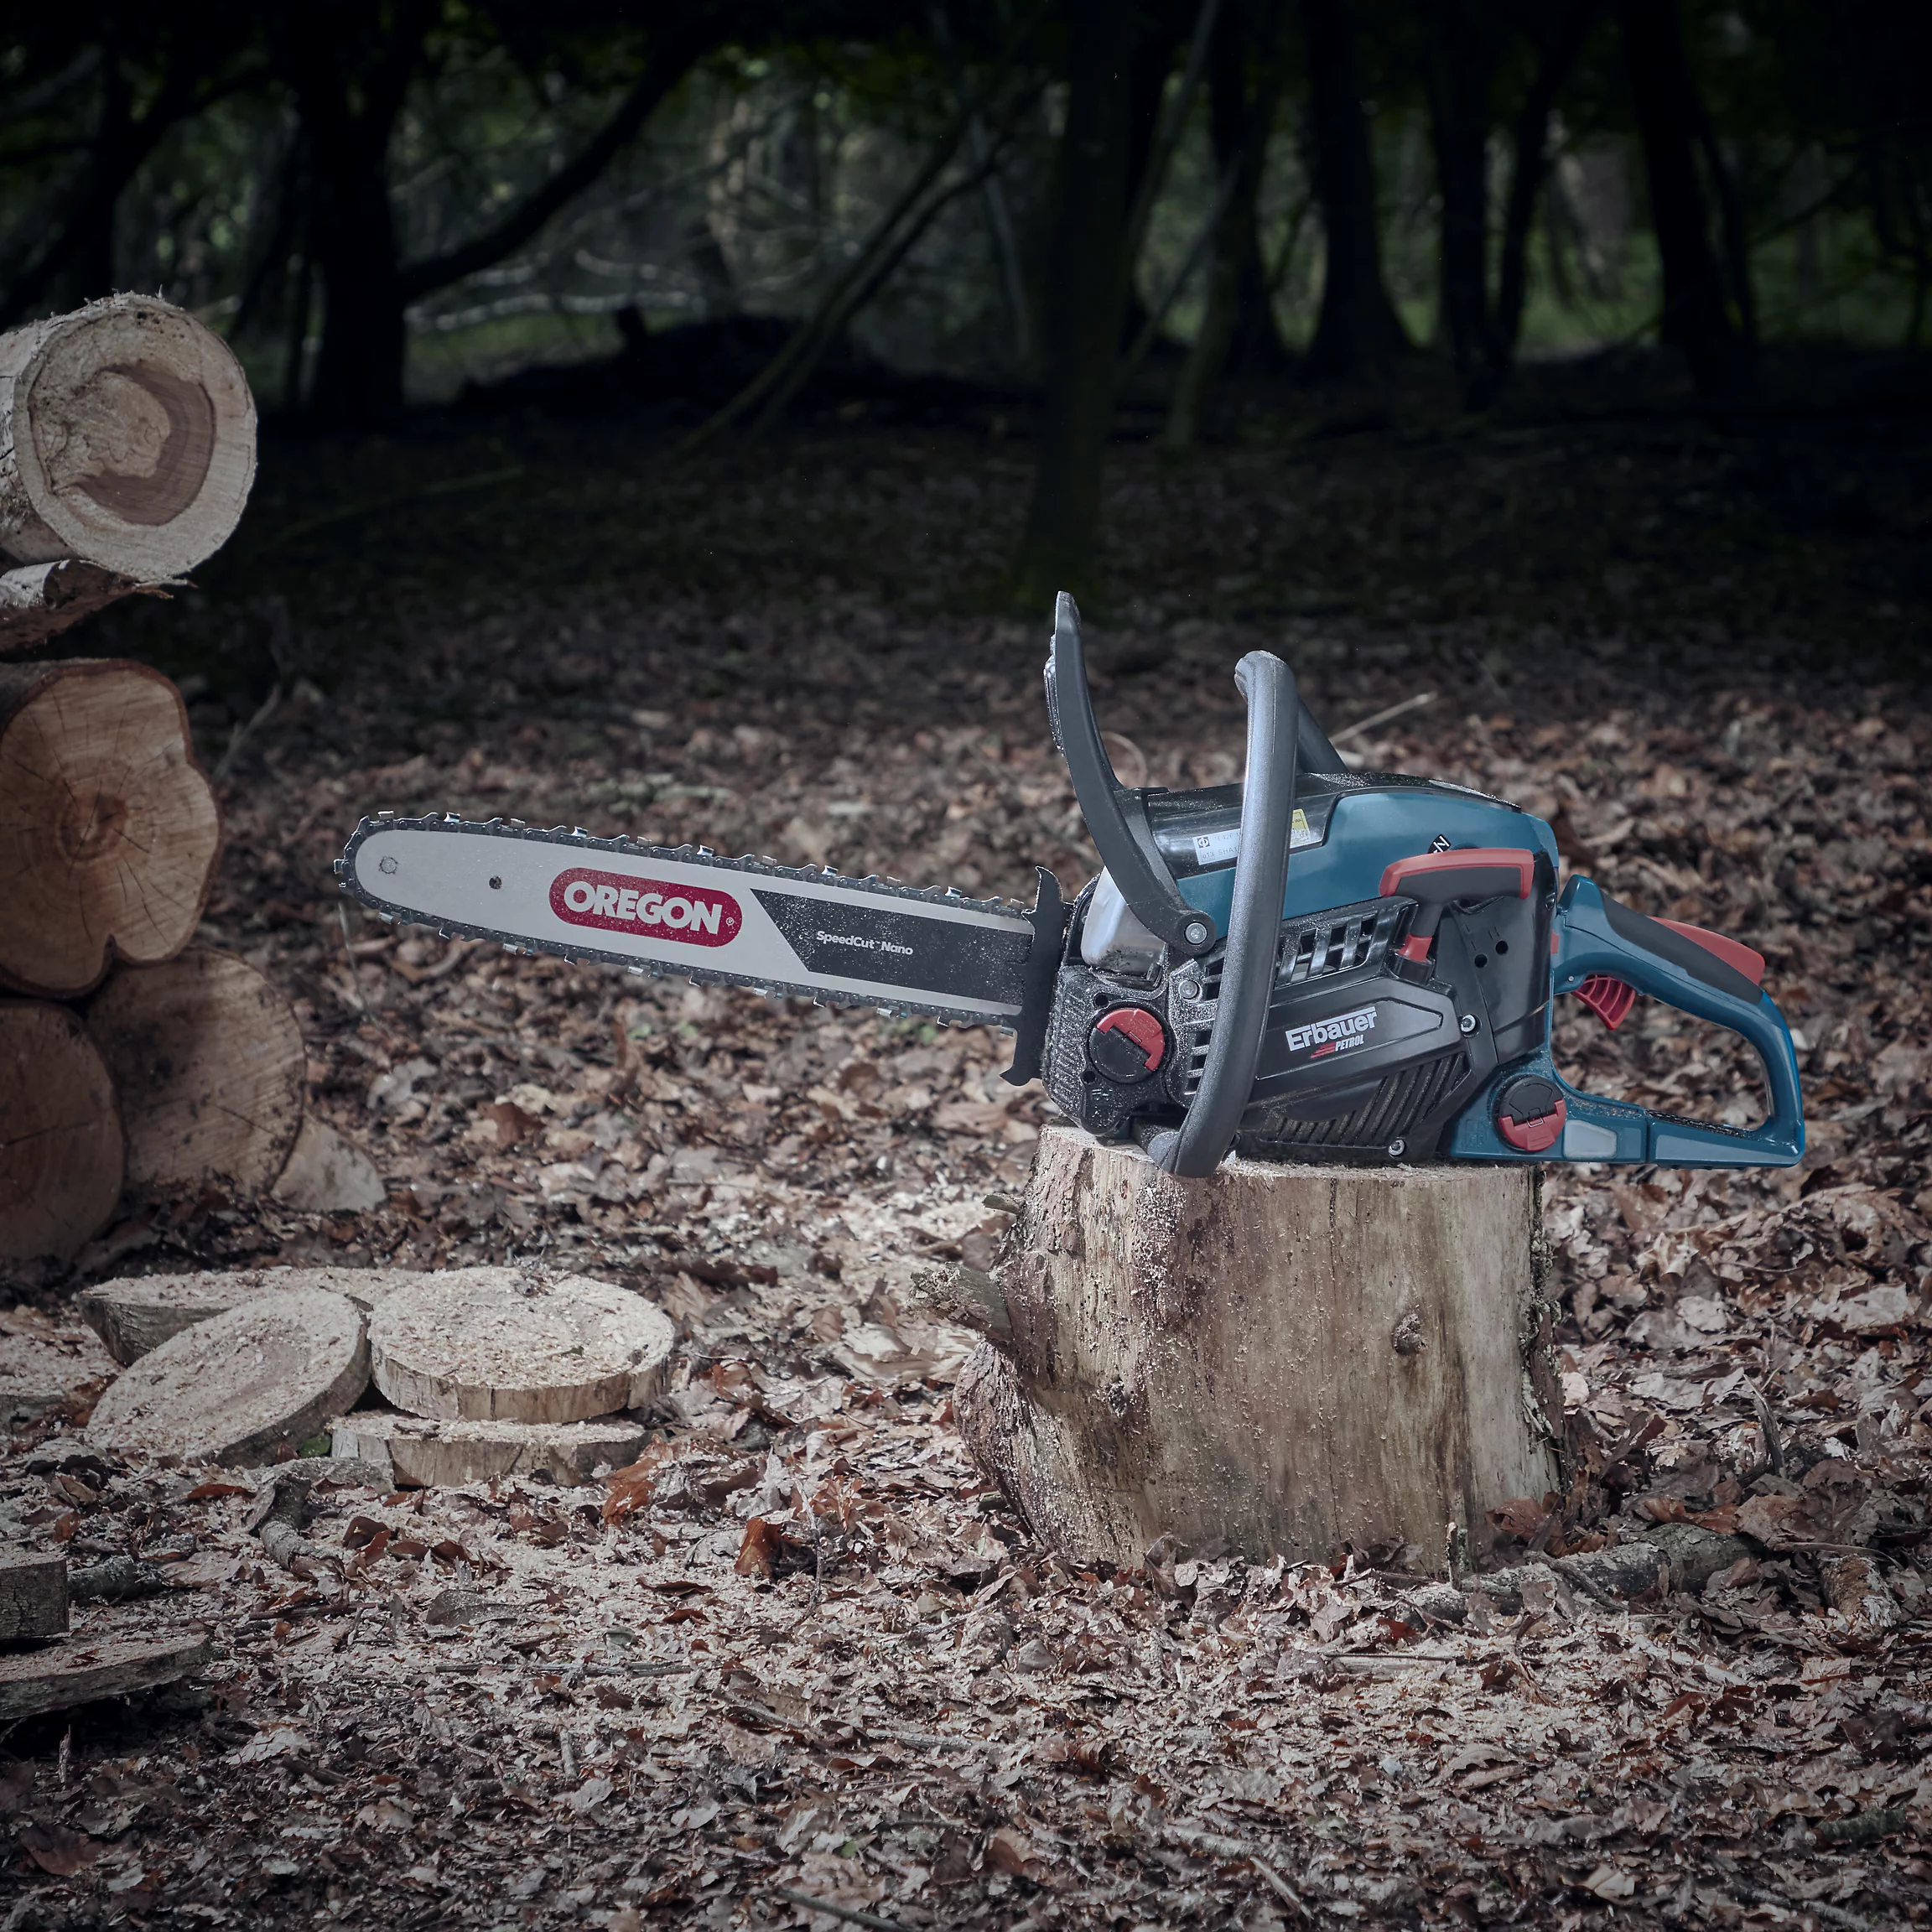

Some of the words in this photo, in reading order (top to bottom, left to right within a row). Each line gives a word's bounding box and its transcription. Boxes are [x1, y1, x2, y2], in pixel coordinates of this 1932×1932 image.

[564, 880, 722, 934] OREGON
[880, 941, 913, 955] Nano
[1285, 1006, 1377, 1052] Erbauer
[1335, 1034, 1364, 1052] PETROL
